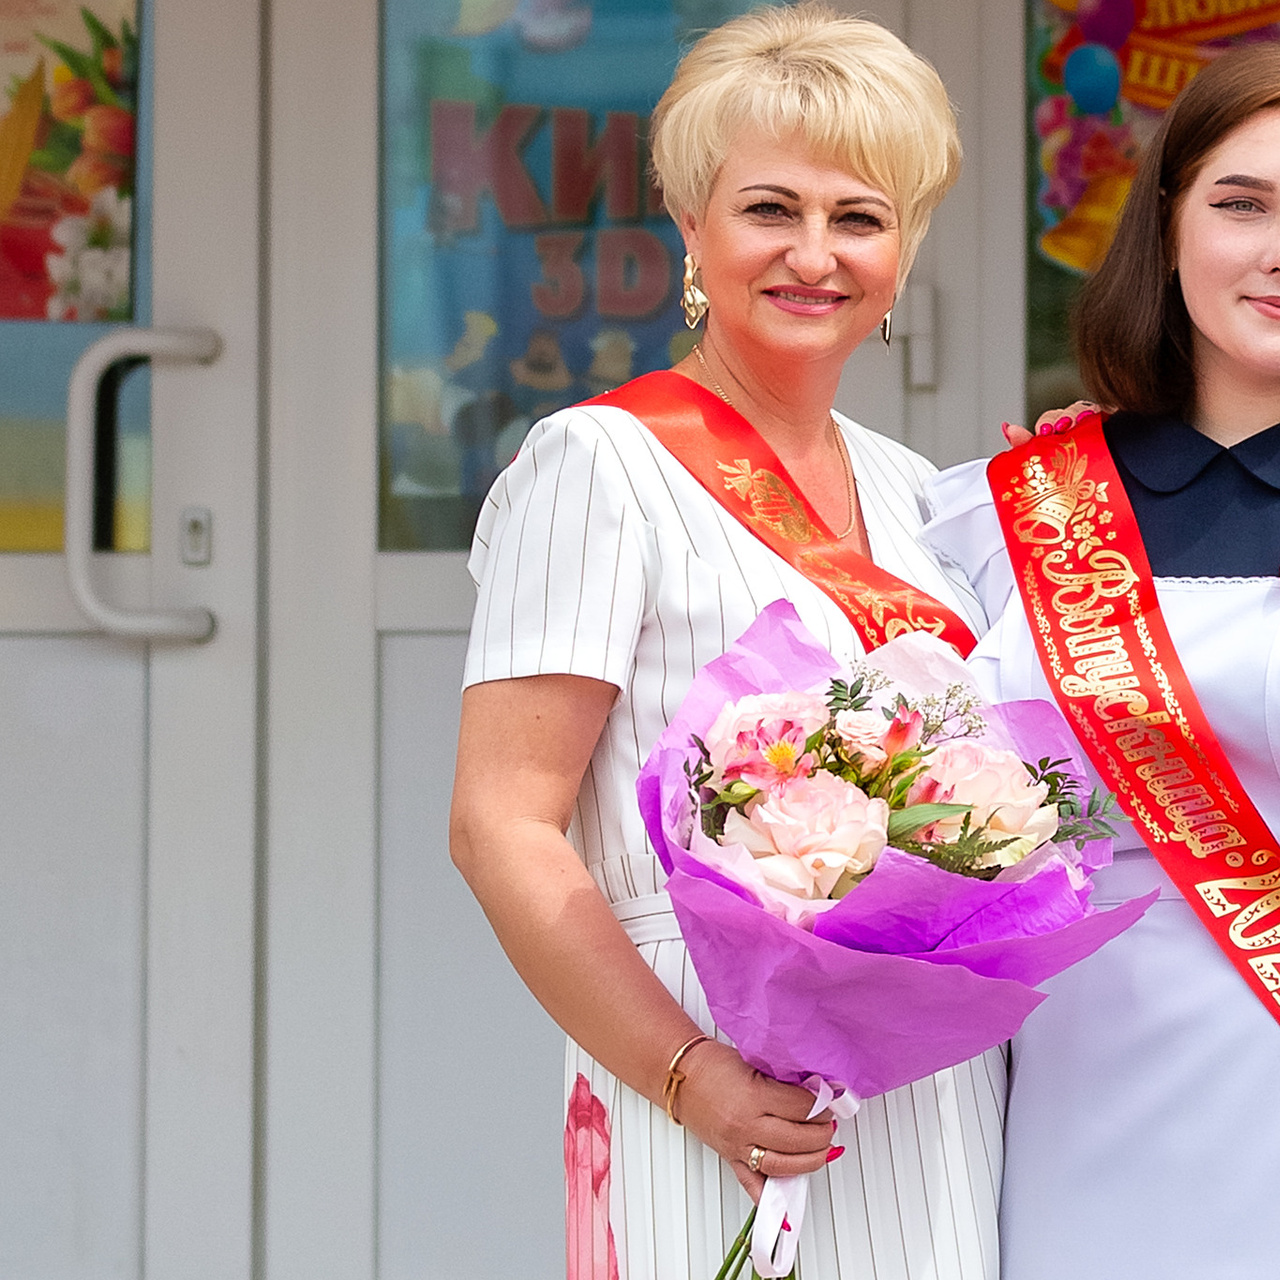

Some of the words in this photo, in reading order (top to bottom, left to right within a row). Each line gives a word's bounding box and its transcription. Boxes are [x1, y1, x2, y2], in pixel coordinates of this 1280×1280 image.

[430, 98, 666, 232] КИ
[531, 227, 670, 318] 3D
[1041, 548, 1247, 859] Выпускница
